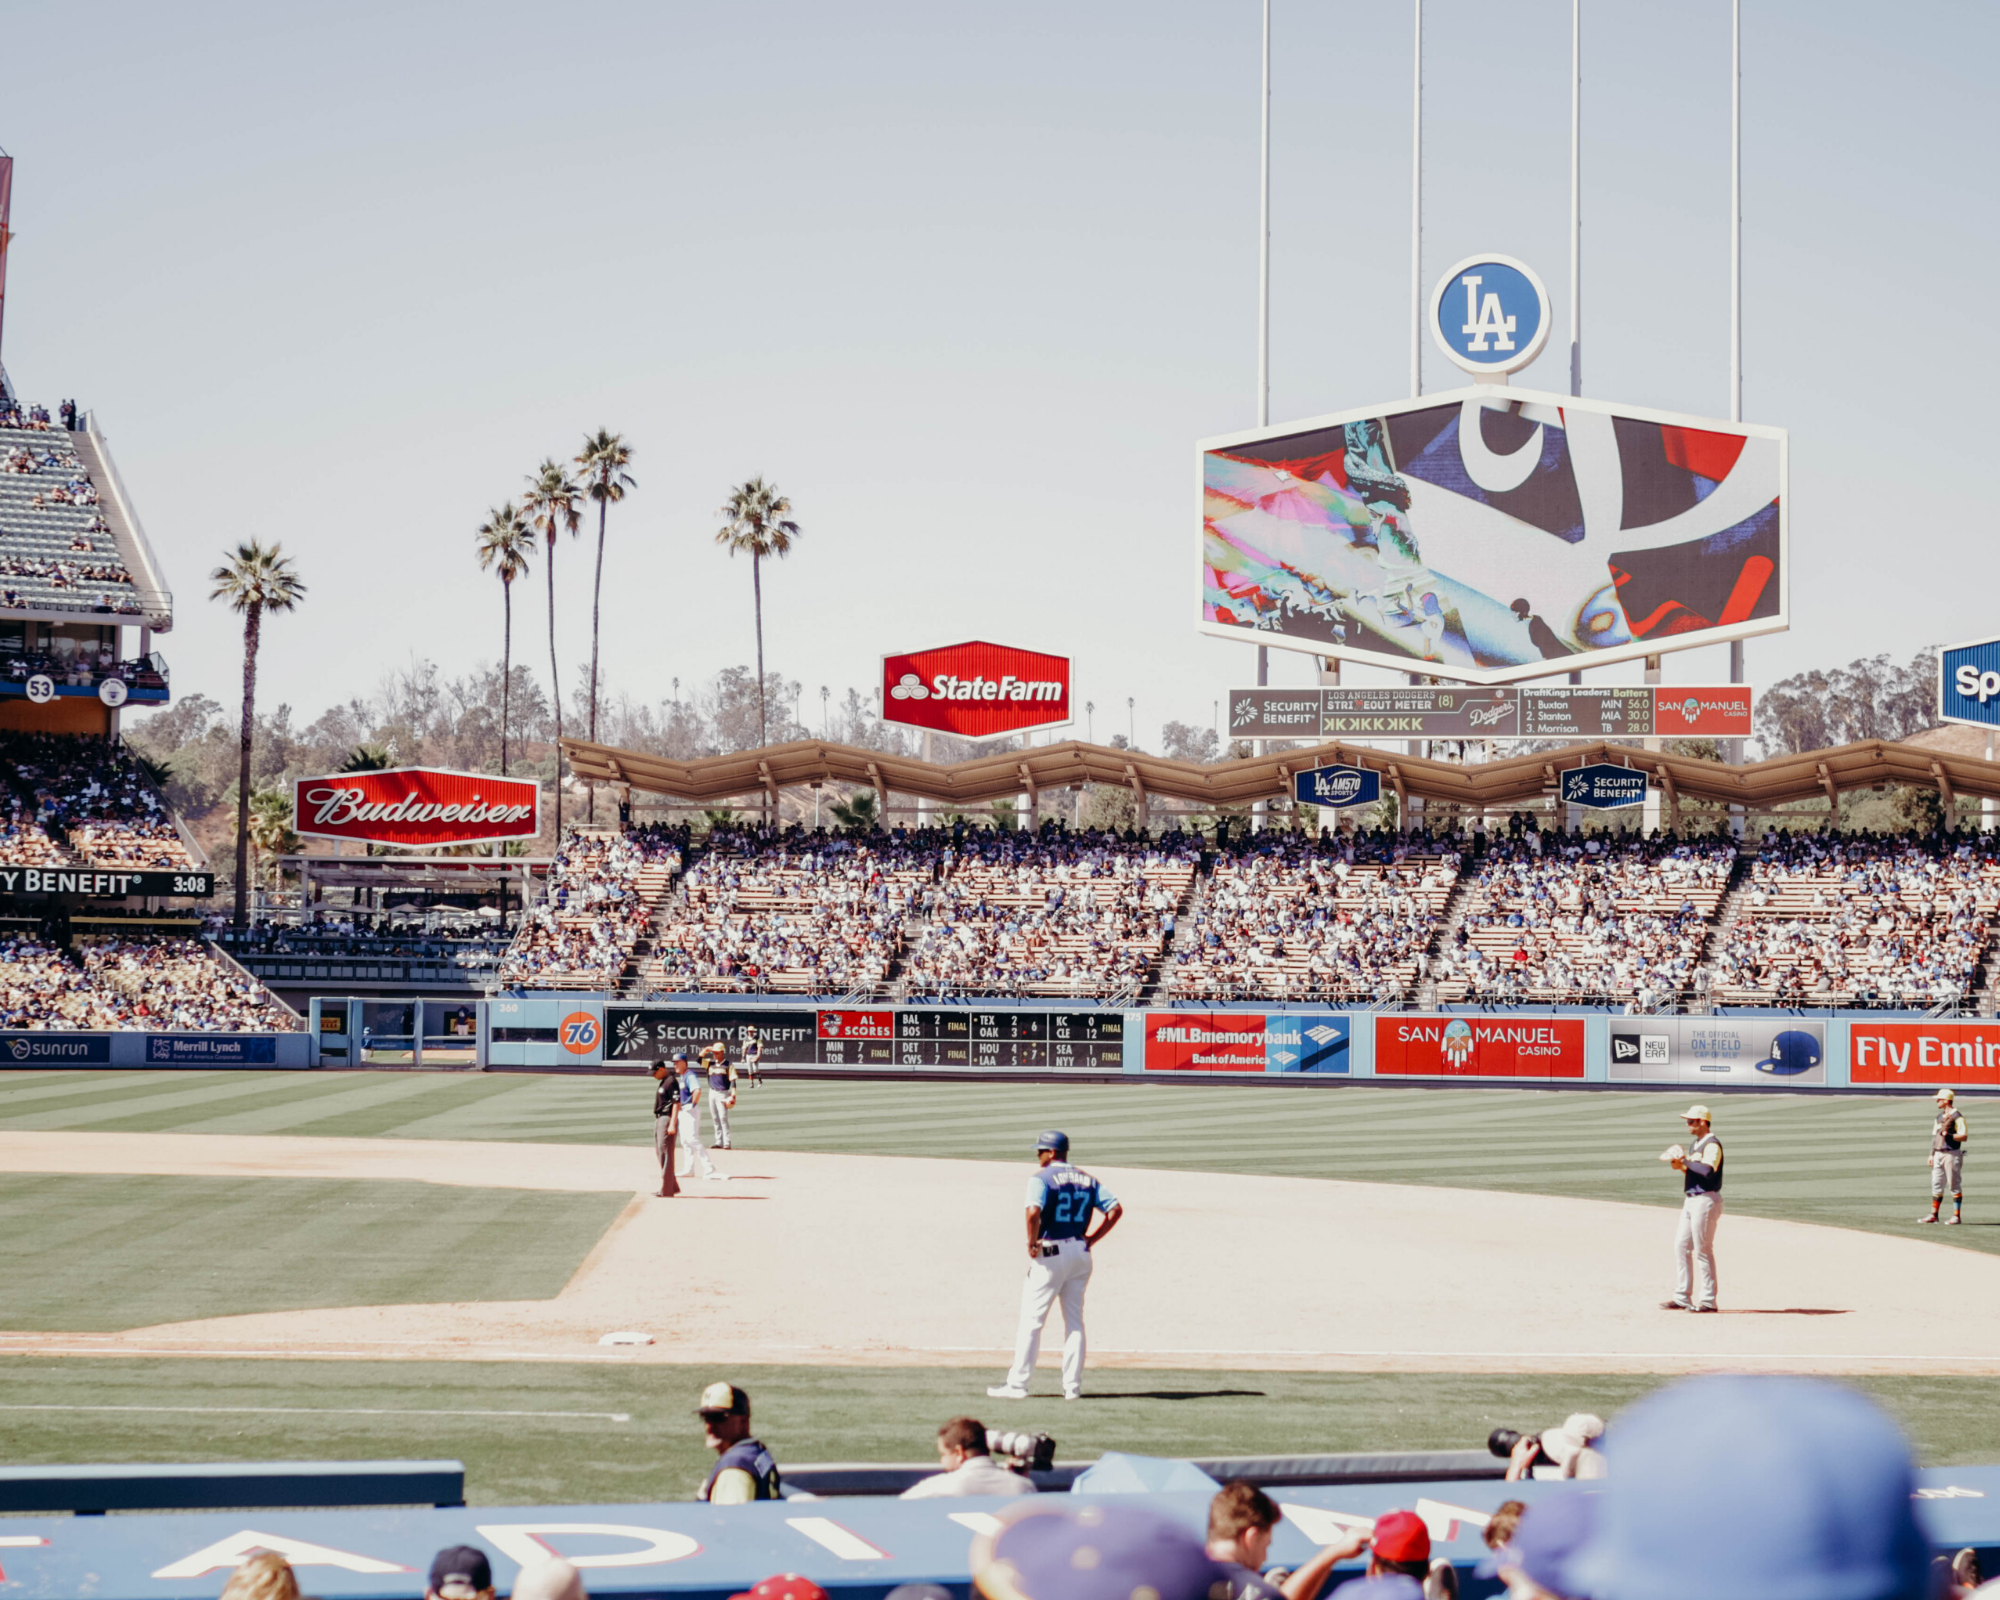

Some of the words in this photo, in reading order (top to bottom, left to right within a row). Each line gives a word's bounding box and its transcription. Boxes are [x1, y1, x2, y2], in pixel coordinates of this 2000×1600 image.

[1461, 275, 1517, 352] LA
[30, 680, 51, 697] 53
[1955, 665, 2000, 703] Sp
[1327, 691, 1346, 700] LOS
[1347, 691, 1391, 700] ANGELES
[1392, 691, 1436, 700] DODGERS
[1523, 688, 1571, 699] DraftKings
[1573, 688, 1611, 697] Leaders:
[1613, 688, 1649, 698] Batters
[1263, 700, 1319, 712] SECURITY
[1394, 700, 1432, 710] METER
[1438, 694, 1454, 708] (8)
[1527, 700, 1535, 710] 1.
[1538, 700, 1568, 710] Buxton
[1601, 699, 1622, 709] MIN
[1627, 699, 1649, 709] 56.0
[1658, 701, 1682, 711] SAN
[1700, 701, 1748, 712] MANUEL
[1469, 701, 1515, 727] Dodgers
[1526, 711, 1535, 721] 2.
[1538, 711, 1571, 721] Stanton
[1601, 711, 1622, 721] MIA
[1627, 711, 1649, 721] 30.0
[1526, 724, 1535, 733] 3.
[1538, 723, 1579, 734] Morrison
[1601, 723, 1613, 733] TB
[1627, 723, 1649, 733] 28.0
[1314, 772, 1331, 796] LA
[1331, 777, 1362, 791] AM570
[1593, 775, 1644, 788] SECURITY
[305, 787, 532, 825] Budweiser
[173, 876, 206, 893] 3:08
[499, 1003, 519, 1013] 360
[860, 1015, 875, 1026] AL
[902, 1014, 920, 1026] BAL
[934, 1014, 941, 1026] 2
[979, 1015, 996, 1026] TEX
[1011, 1015, 1018, 1026] 2
[1055, 1016, 1068, 1027] KC
[1088, 1016, 1095, 1027] 0
[1123, 1013, 1141, 1022] 375
[844, 1025, 891, 1037] SCORES
[902, 1026, 920, 1038] BOS
[935, 1026, 940, 1037] 1
[947, 1021, 968, 1032] FINAL
[1030, 1021, 1038, 1032] 6
[1101, 1023, 1122, 1033] FINAL
[564, 1019, 597, 1046] 76
[657, 1024, 735, 1042] SECURITY
[979, 1027, 999, 1038] OAK
[1011, 1027, 1018, 1038] 3
[1055, 1028, 1072, 1039] CLE
[1085, 1028, 1098, 1039] 12
[1156, 1027, 1302, 1048] #MLBmemorybank
[1397, 1026, 1439, 1043] SAN
[1475, 1028, 1562, 1044] MANUEL
[1692, 1031, 1706, 1039] THE
[1708, 1031, 1740, 1039] OFFICIAL
[32, 1042, 88, 1057] sunrun
[173, 1040, 208, 1052] Merrill
[210, 1040, 241, 1054] Lynch
[657, 1044, 668, 1055] To
[670, 1044, 688, 1055] and
[825, 1041, 844, 1053] MIN
[857, 1041, 865, 1053] 7
[902, 1042, 920, 1053] DET
[935, 1042, 940, 1053] 1
[979, 1043, 1000, 1054] HOU
[1011, 1043, 1018, 1054] 4
[1055, 1044, 1073, 1055] SEA
[1088, 1044, 1094, 1055] 1
[1645, 1041, 1666, 1050] NEW
[1691, 1039, 1742, 1051] ON-FIELD
[870, 1048, 890, 1059] FINAL
[947, 1050, 968, 1060] FINAL
[1030, 1049, 1038, 1060] 7
[1101, 1051, 1122, 1062] FINAL
[1517, 1046, 1561, 1056] CASINO
[1645, 1050, 1666, 1059] ERA
[1694, 1051, 1709, 1059] CAP
[1711, 1051, 1721, 1059] OF
[1856, 1036, 1912, 1073] Fly
[1916, 1036, 2000, 1068] Emir
[825, 1053, 844, 1064] TOR
[857, 1053, 865, 1064] 2
[902, 1054, 922, 1065] CWS
[934, 1054, 941, 1065] 7
[979, 1055, 997, 1066] LAA
[1011, 1055, 1018, 1066] 5
[1055, 1056, 1075, 1067] NYY
[1085, 1056, 1098, 1067] 10
[1192, 1053, 1218, 1065] Bank
[1218, 1053, 1230, 1065] of
[1230, 1054, 1271, 1066] America
[1055, 1191, 1090, 1223] 27
